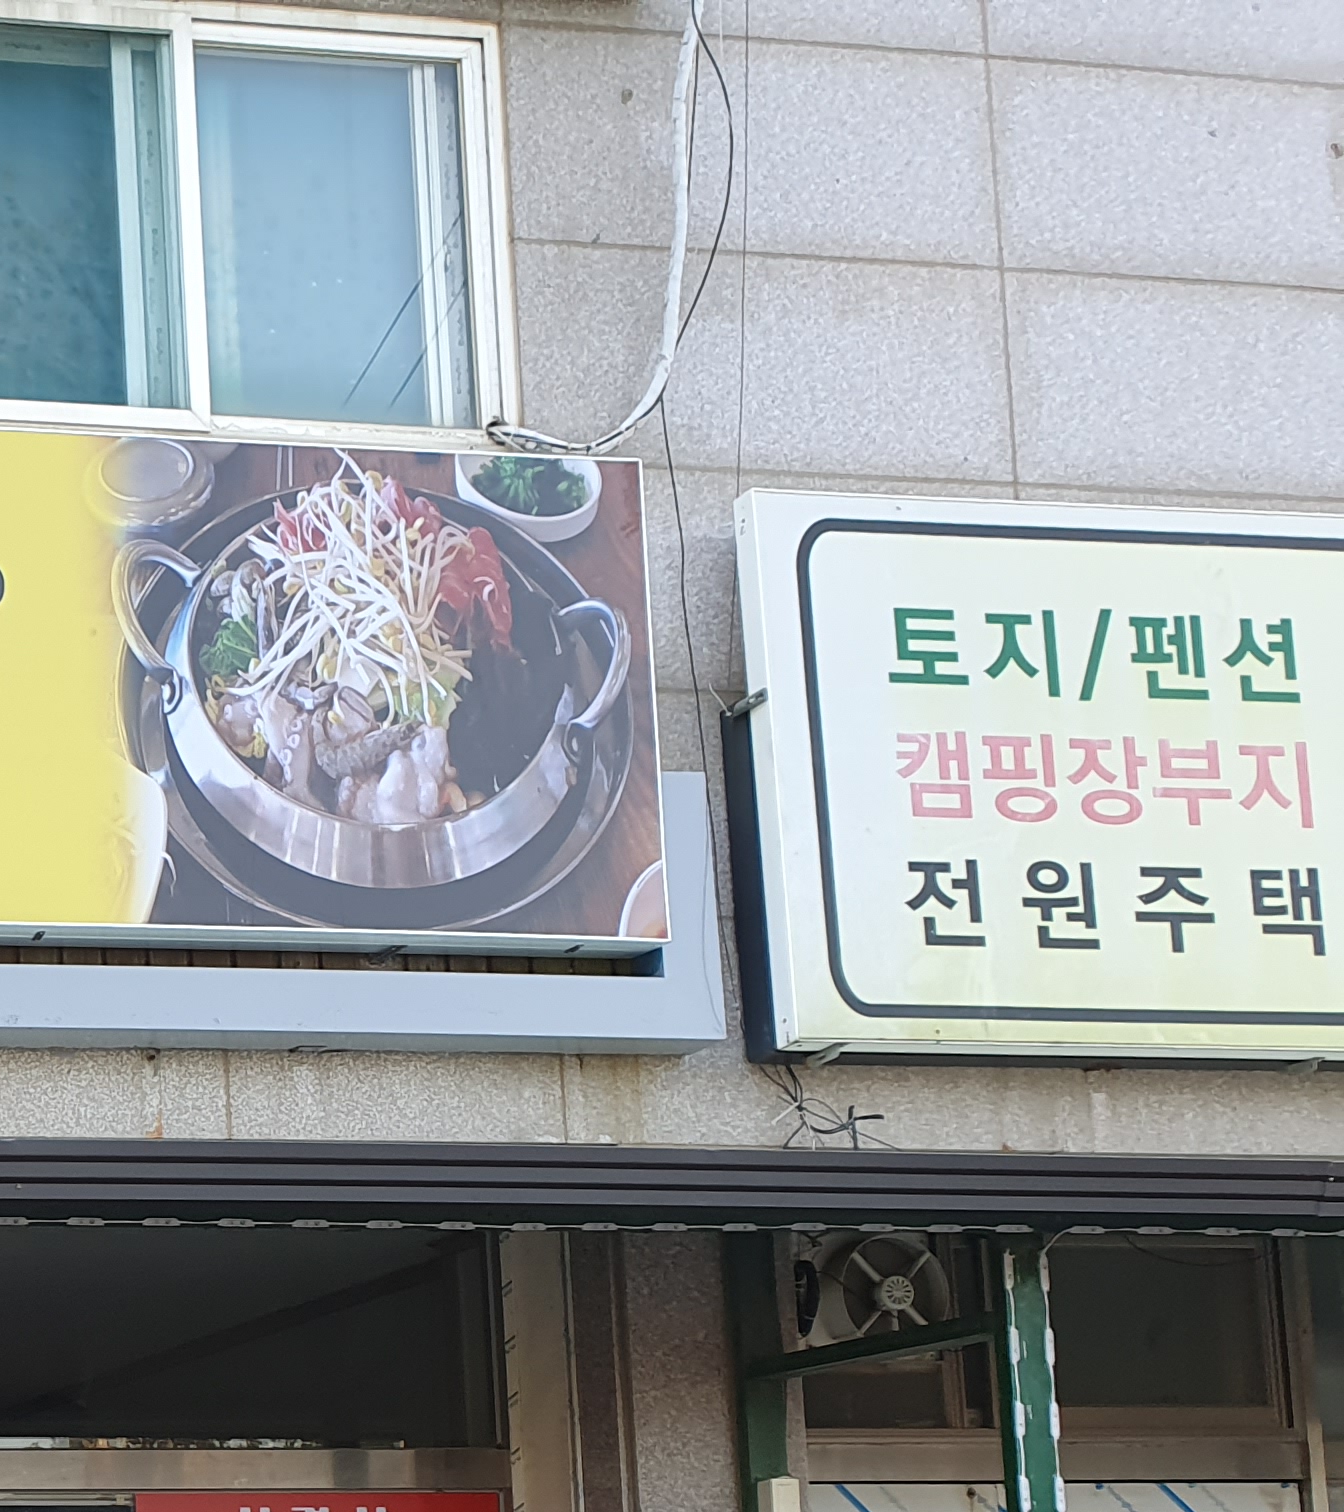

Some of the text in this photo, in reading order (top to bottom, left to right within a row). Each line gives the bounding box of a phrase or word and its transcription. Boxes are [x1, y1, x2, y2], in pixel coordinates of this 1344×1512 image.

[888, 606, 1303, 704] 토지/펜션
[895, 731, 1316, 830] 캠핑장부지
[904, 858, 1326, 957] 전원주택
